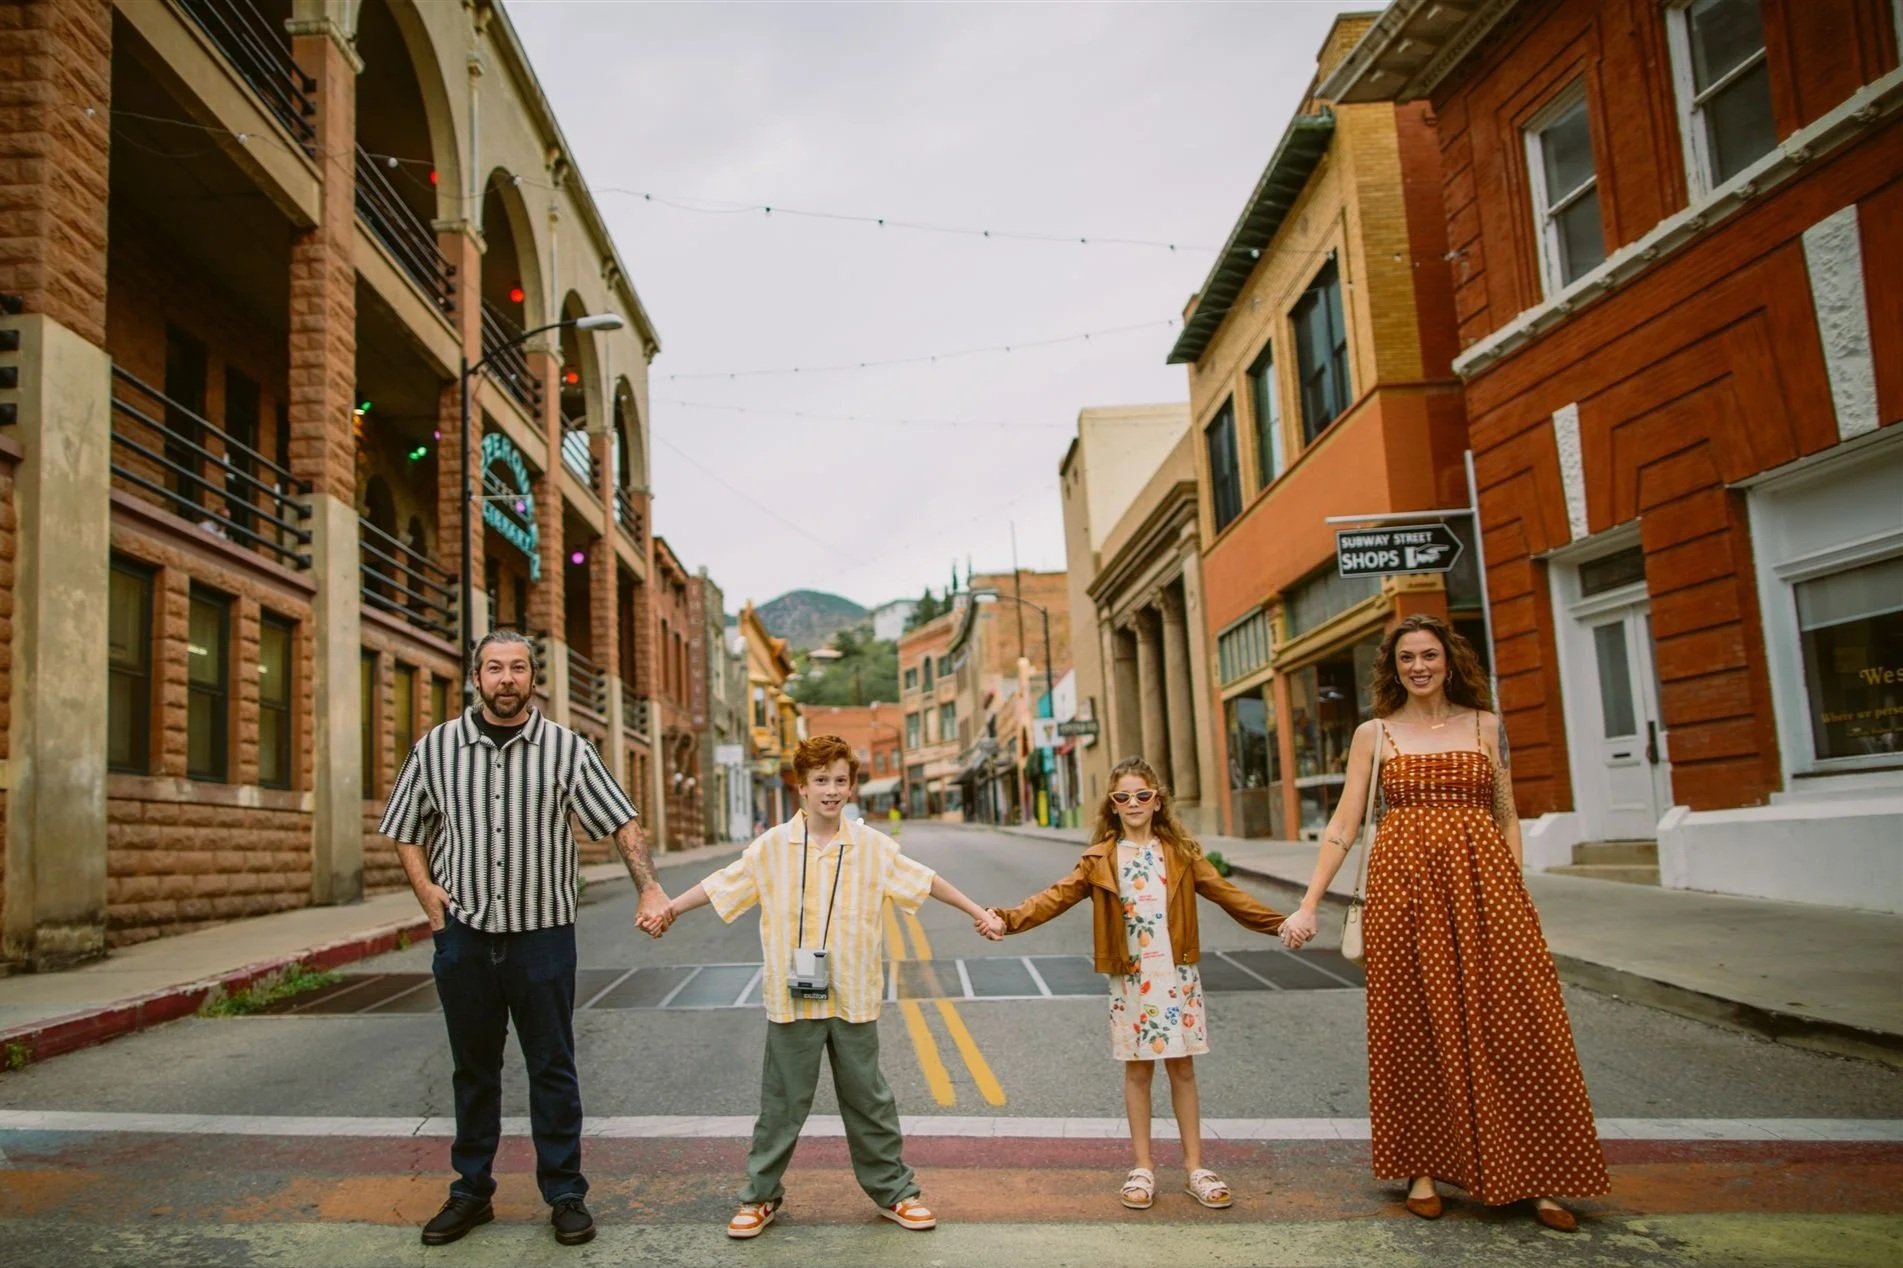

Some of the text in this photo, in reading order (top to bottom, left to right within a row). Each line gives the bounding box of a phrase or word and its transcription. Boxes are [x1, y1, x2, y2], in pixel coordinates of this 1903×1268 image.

[1342, 532, 1432, 549] SUBWAY STREET
[1342, 551, 1399, 569] SHOPS
